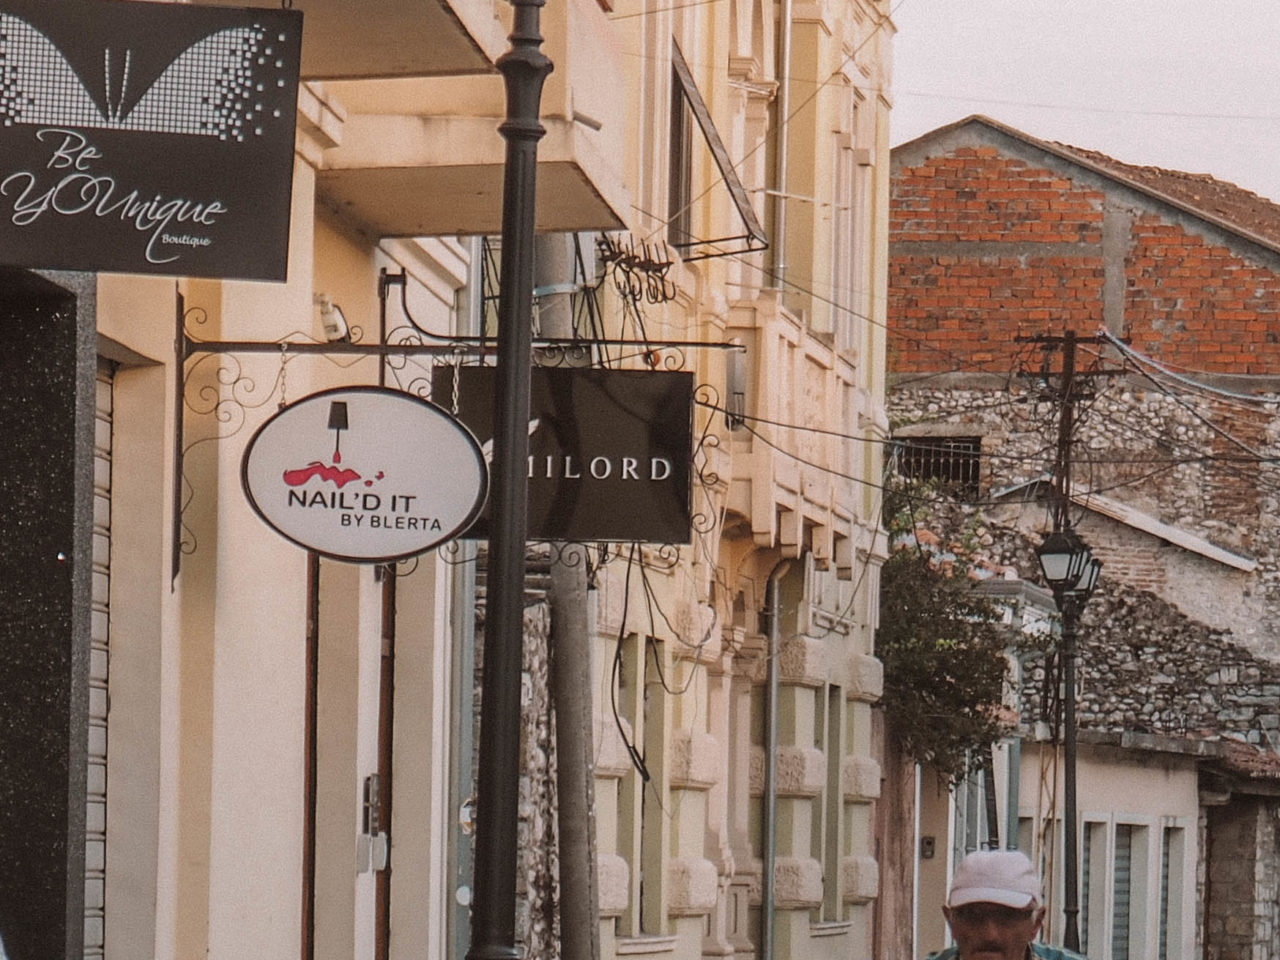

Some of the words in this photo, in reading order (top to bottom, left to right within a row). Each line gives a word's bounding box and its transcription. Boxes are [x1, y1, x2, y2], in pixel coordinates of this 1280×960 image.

[36, 129, 102, 169] Be
[0, 172, 228, 264] YOUnique
[161, 233, 212, 248] Boutique
[288, 489, 381, 511] NAIL'D
[391, 495, 417, 513] IT
[341, 513, 364, 527] BY
[370, 515, 442, 531] BLERTA
